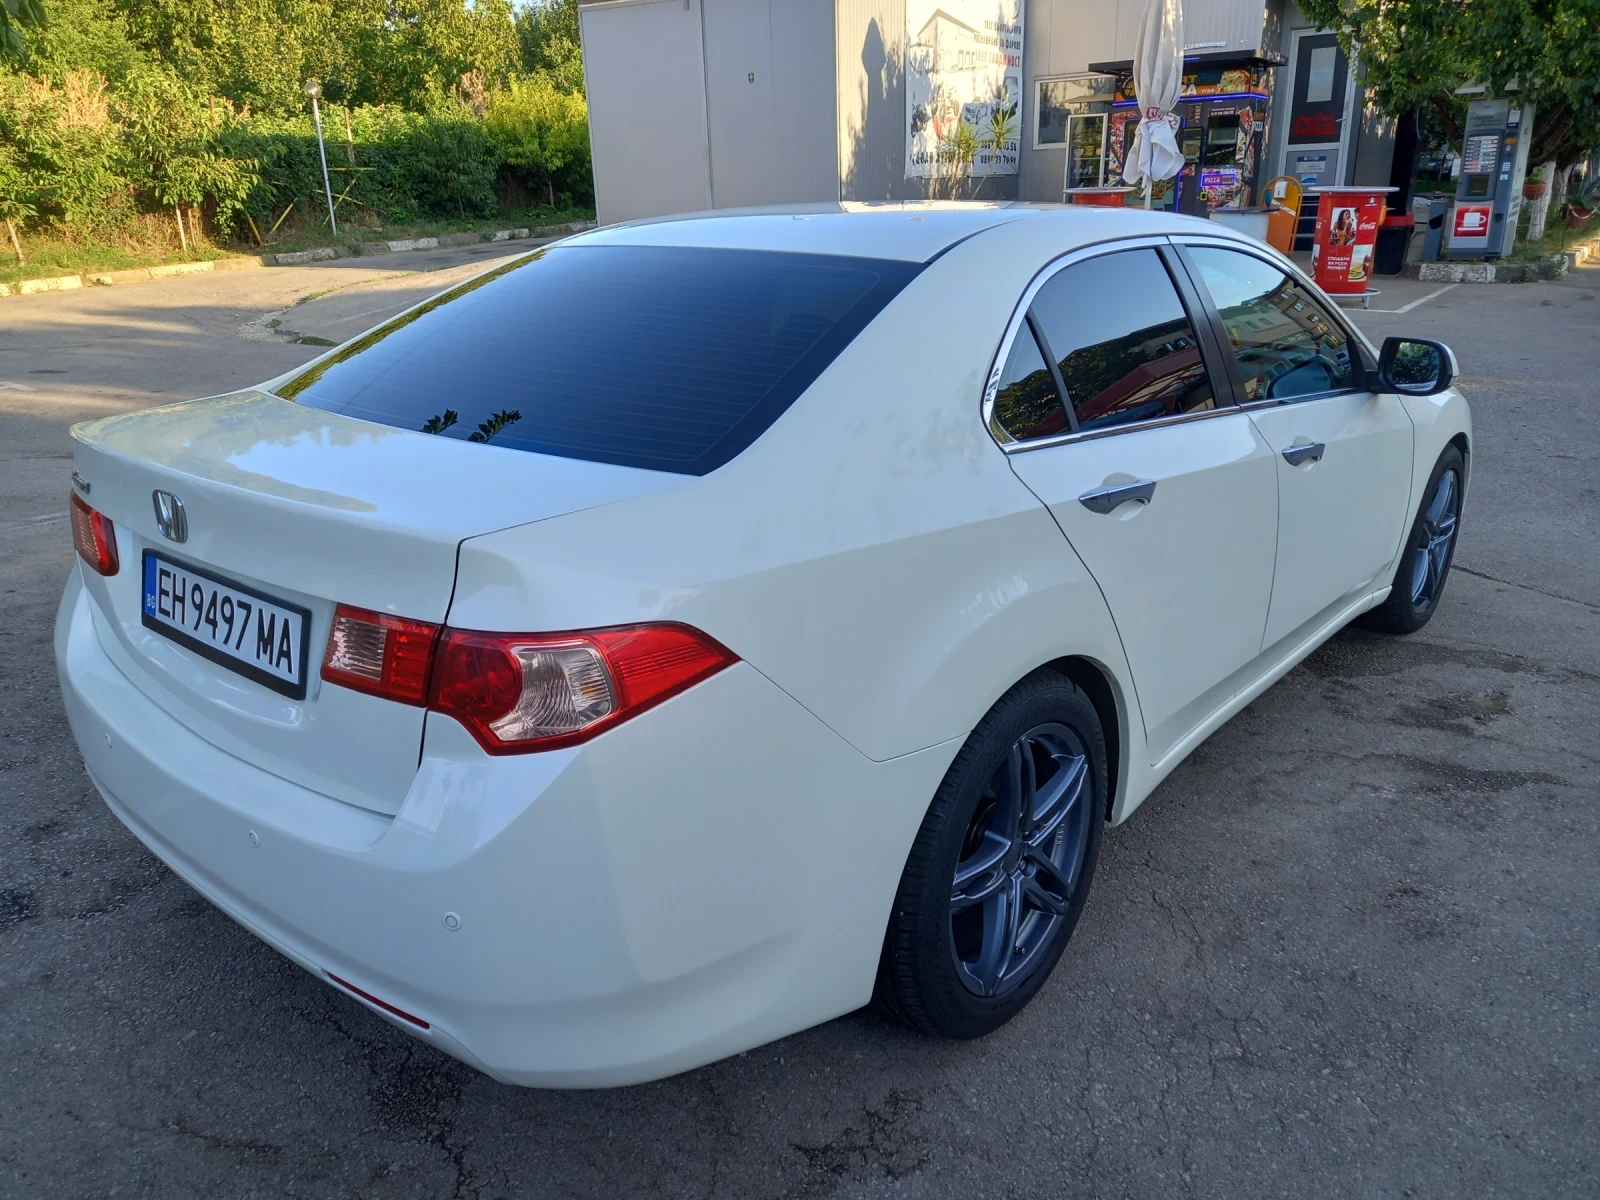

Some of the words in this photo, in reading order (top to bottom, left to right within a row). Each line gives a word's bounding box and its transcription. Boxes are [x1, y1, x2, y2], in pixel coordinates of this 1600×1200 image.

[146, 593, 156, 610] BG
[191, 583, 252, 652] 9497
[255, 607, 293, 675] MA
